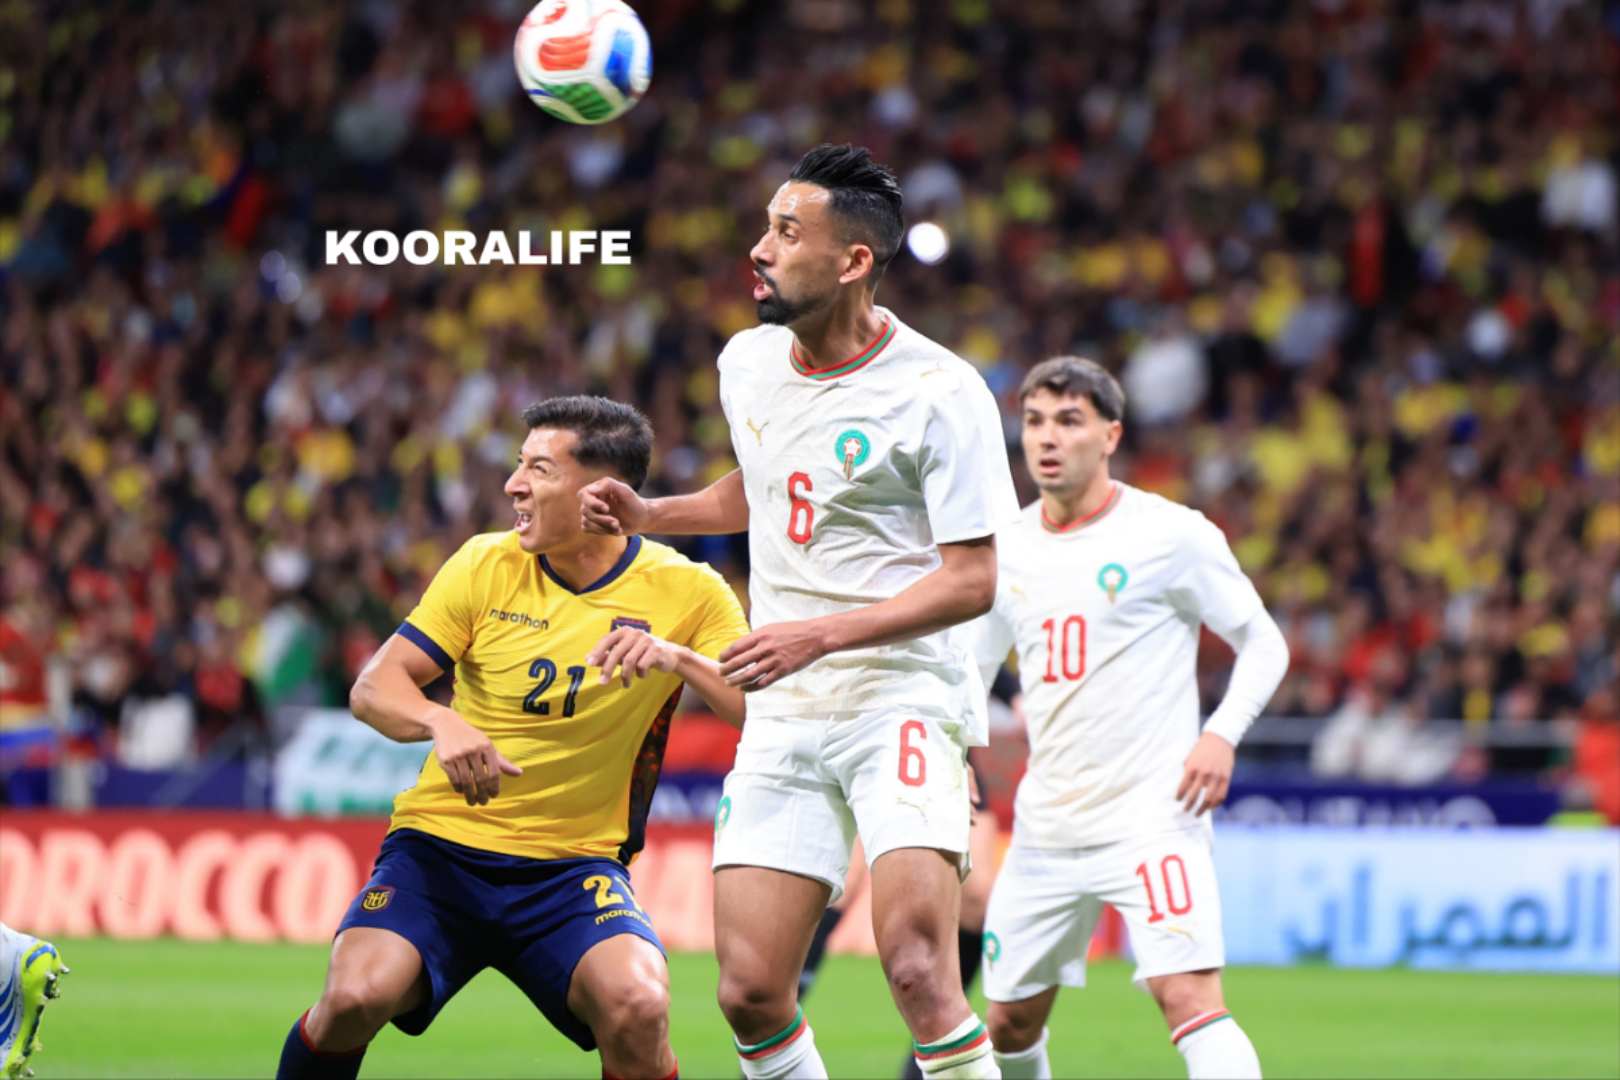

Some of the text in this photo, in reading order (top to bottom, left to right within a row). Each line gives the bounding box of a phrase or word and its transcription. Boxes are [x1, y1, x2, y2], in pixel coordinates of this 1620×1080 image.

[787, 471, 814, 544] 6
[489, 608, 550, 630] marathon
[1042, 615, 1087, 683] 10
[523, 658, 586, 717] 21
[898, 720, 928, 787] 6
[1136, 854, 1193, 923] 10
